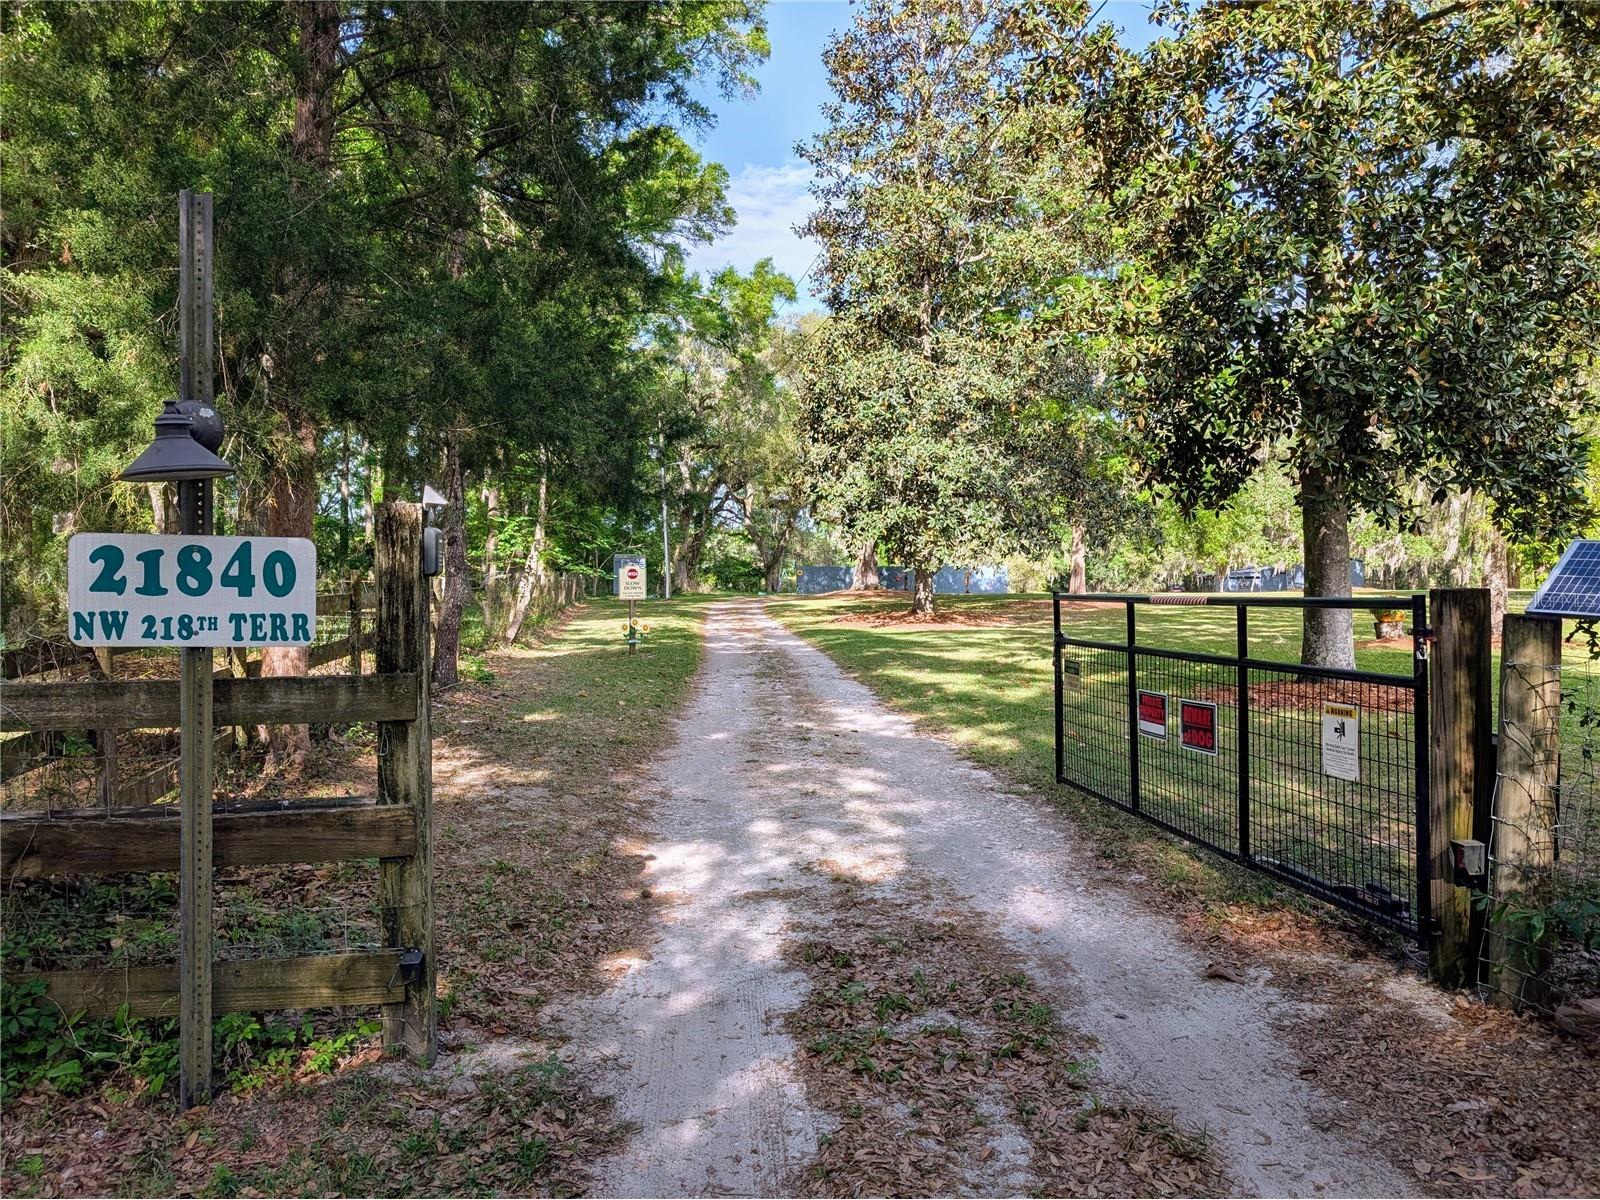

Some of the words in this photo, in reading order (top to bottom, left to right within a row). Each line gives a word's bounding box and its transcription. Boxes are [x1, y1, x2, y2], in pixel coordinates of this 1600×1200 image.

[89, 541, 296, 597] 21840
[72, 610, 129, 641] NW
[141, 613, 218, 641] 218TH
[228, 613, 311, 642] TERR
[1183, 705, 1211, 726] BEWARE
[1330, 707, 1353, 718] WARNING
[1191, 730, 1213, 747] DOG
